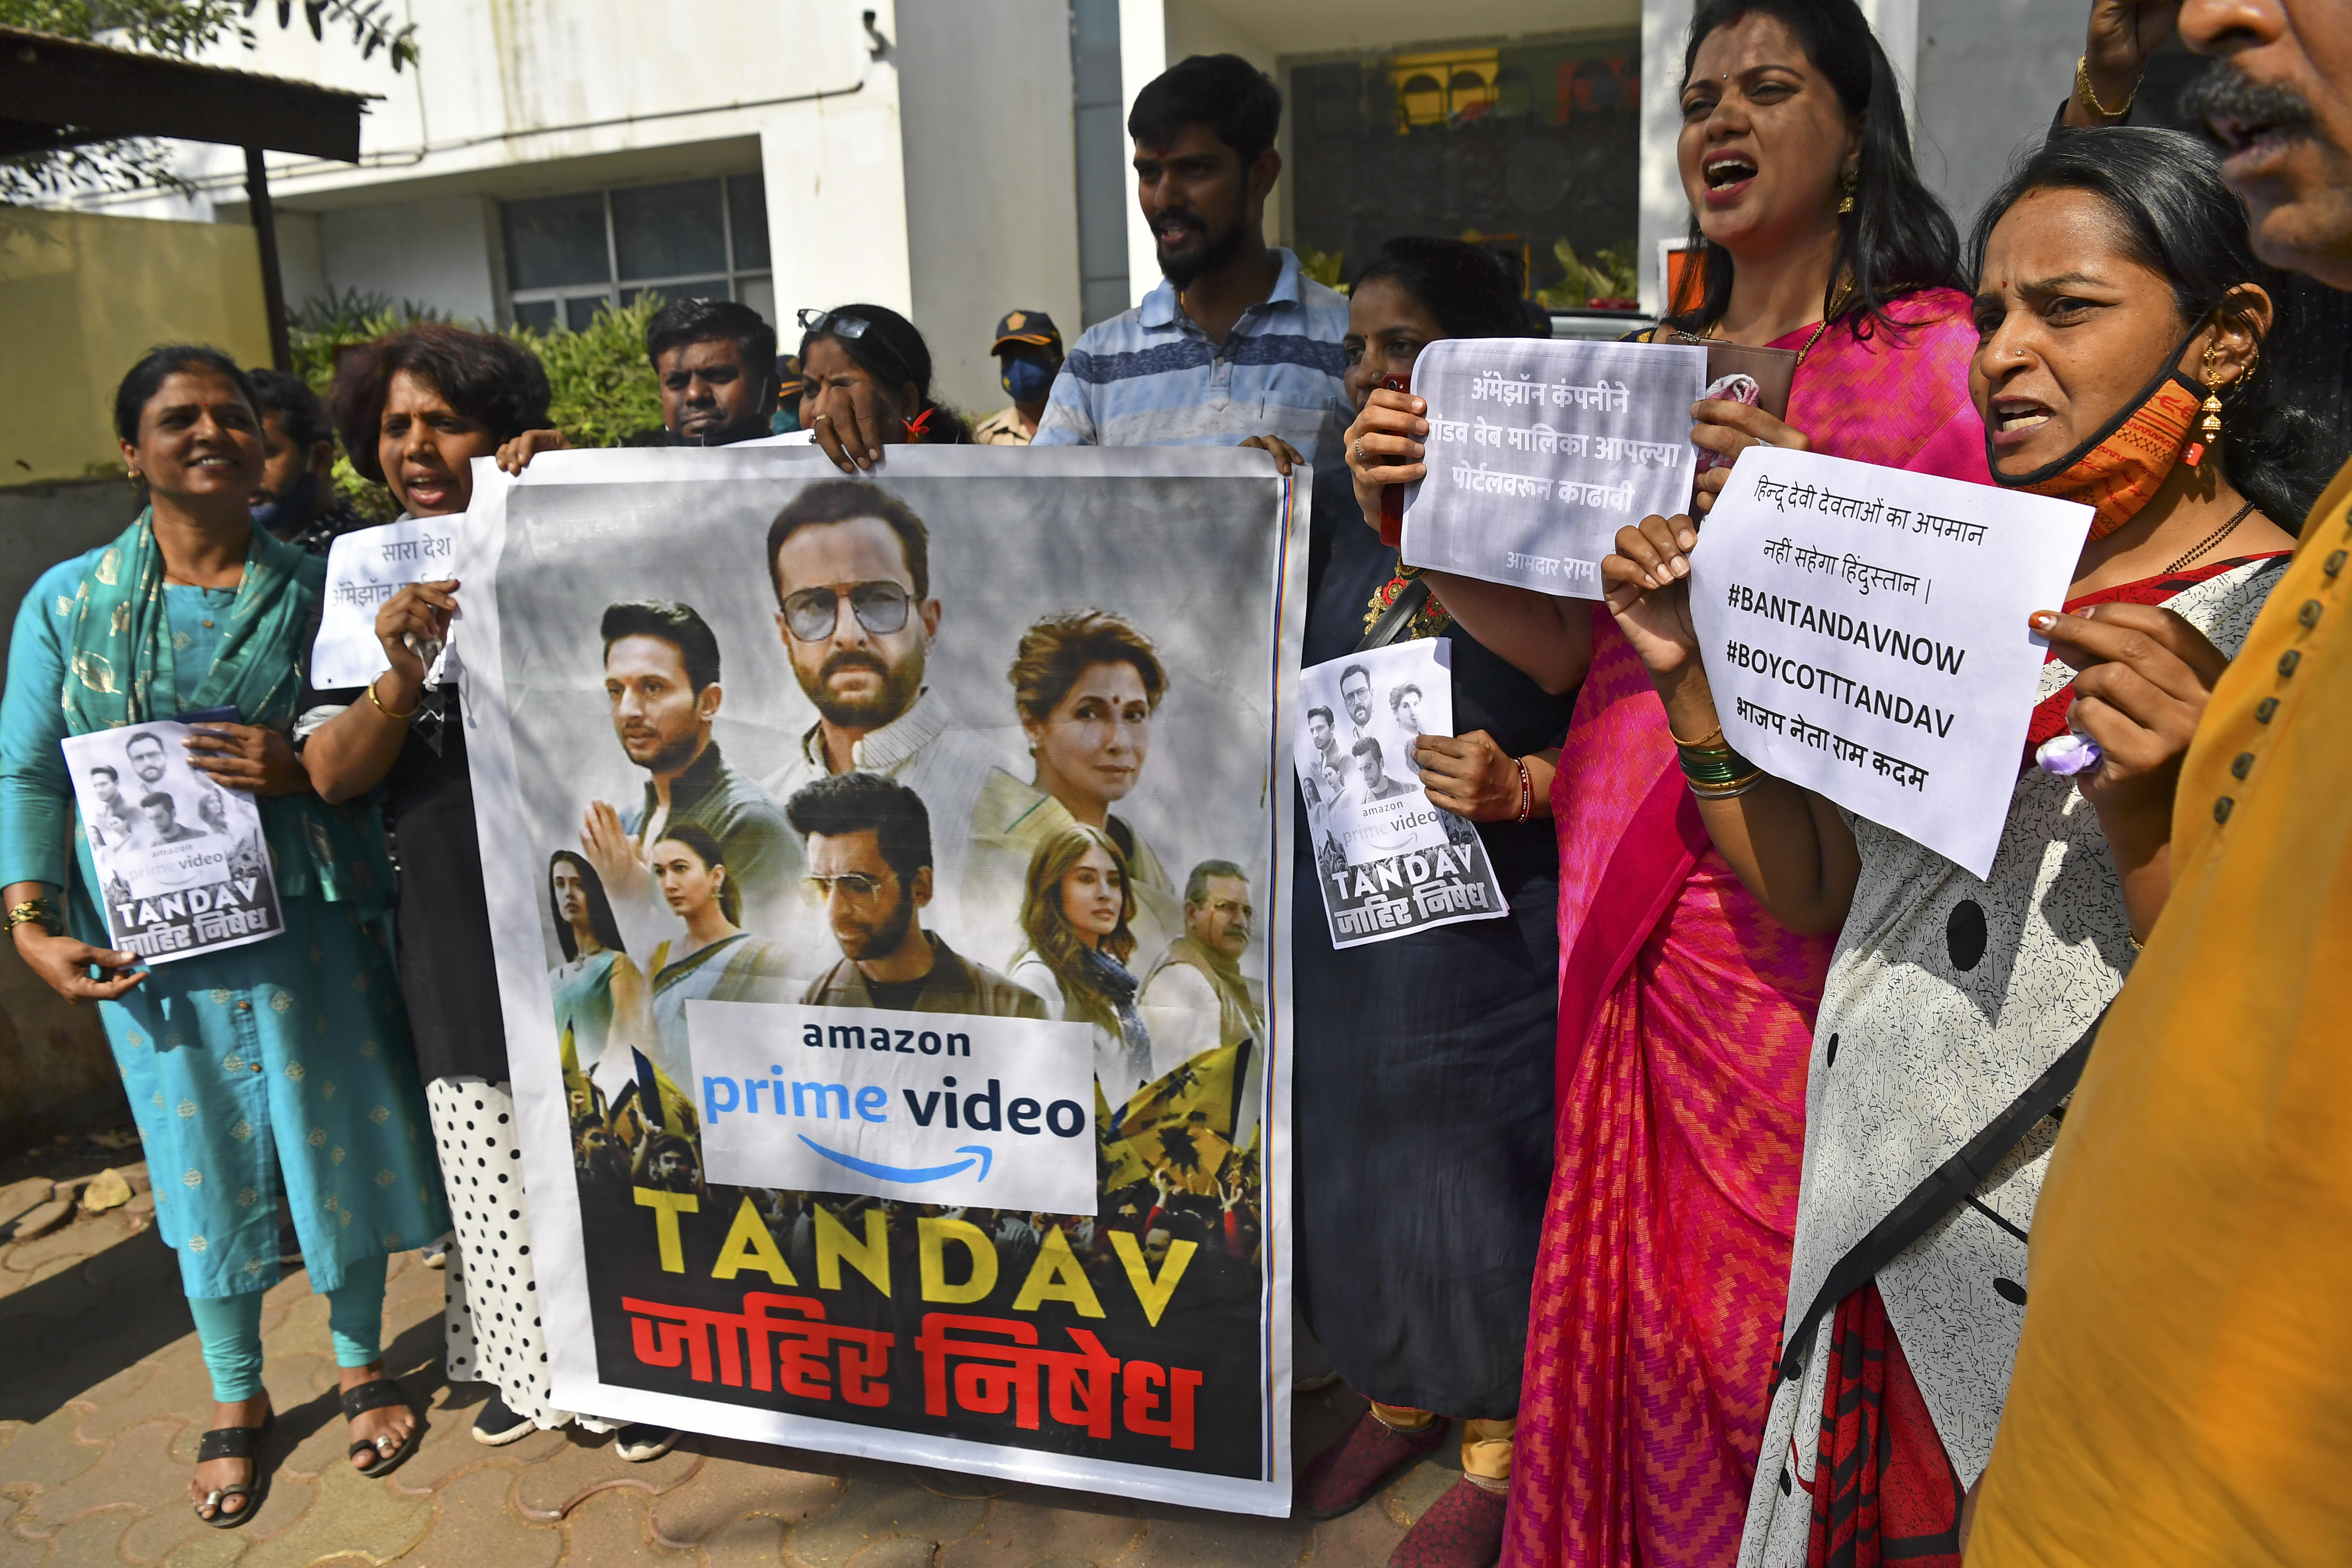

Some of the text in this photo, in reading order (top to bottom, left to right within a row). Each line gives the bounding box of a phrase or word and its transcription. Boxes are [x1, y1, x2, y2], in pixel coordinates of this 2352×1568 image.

[1552, 378, 1630, 413] कंपनीने
[1474, 416, 1503, 448] वेब
[1508, 423, 1589, 457] मालिका
[1594, 437, 1682, 467] आपल्या
[1452, 460, 1635, 512] पोर्टलवरून काढावी
[1754, 475, 1988, 546] हिन्दू देवी देवताओं का अपमान
[382, 534, 451, 561] सारा देश
[1506, 552, 1596, 582] आमदार राम
[1764, 537, 1793, 564] नहीं
[1794, 544, 1839, 575] सहेगा
[1841, 553, 1920, 596] हिंदुस्तान
[1727, 583, 1966, 675] #BANTANDAVNOW
[1726, 640, 1955, 738] #BOYCOTTTANDAV
[1737, 697, 1929, 792] भाजप नेता राम कदम
[1343, 811, 1438, 847] prime video
[1362, 801, 1404, 817] amazon
[151, 844, 192, 857] amazon
[178, 853, 222, 869] video
[1331, 844, 1471, 900] TANDAV
[115, 877, 257, 928] TANDAV
[1334, 877, 1489, 934] जाहिर निषेध
[117, 906, 268, 956] जाहिर निषेध
[803, 1022, 972, 1057] amazon
[702, 1064, 1086, 1138] prime video
[634, 1185, 1198, 1328] TANDAV
[622, 1291, 1203, 1451] जाहिर निषेध
